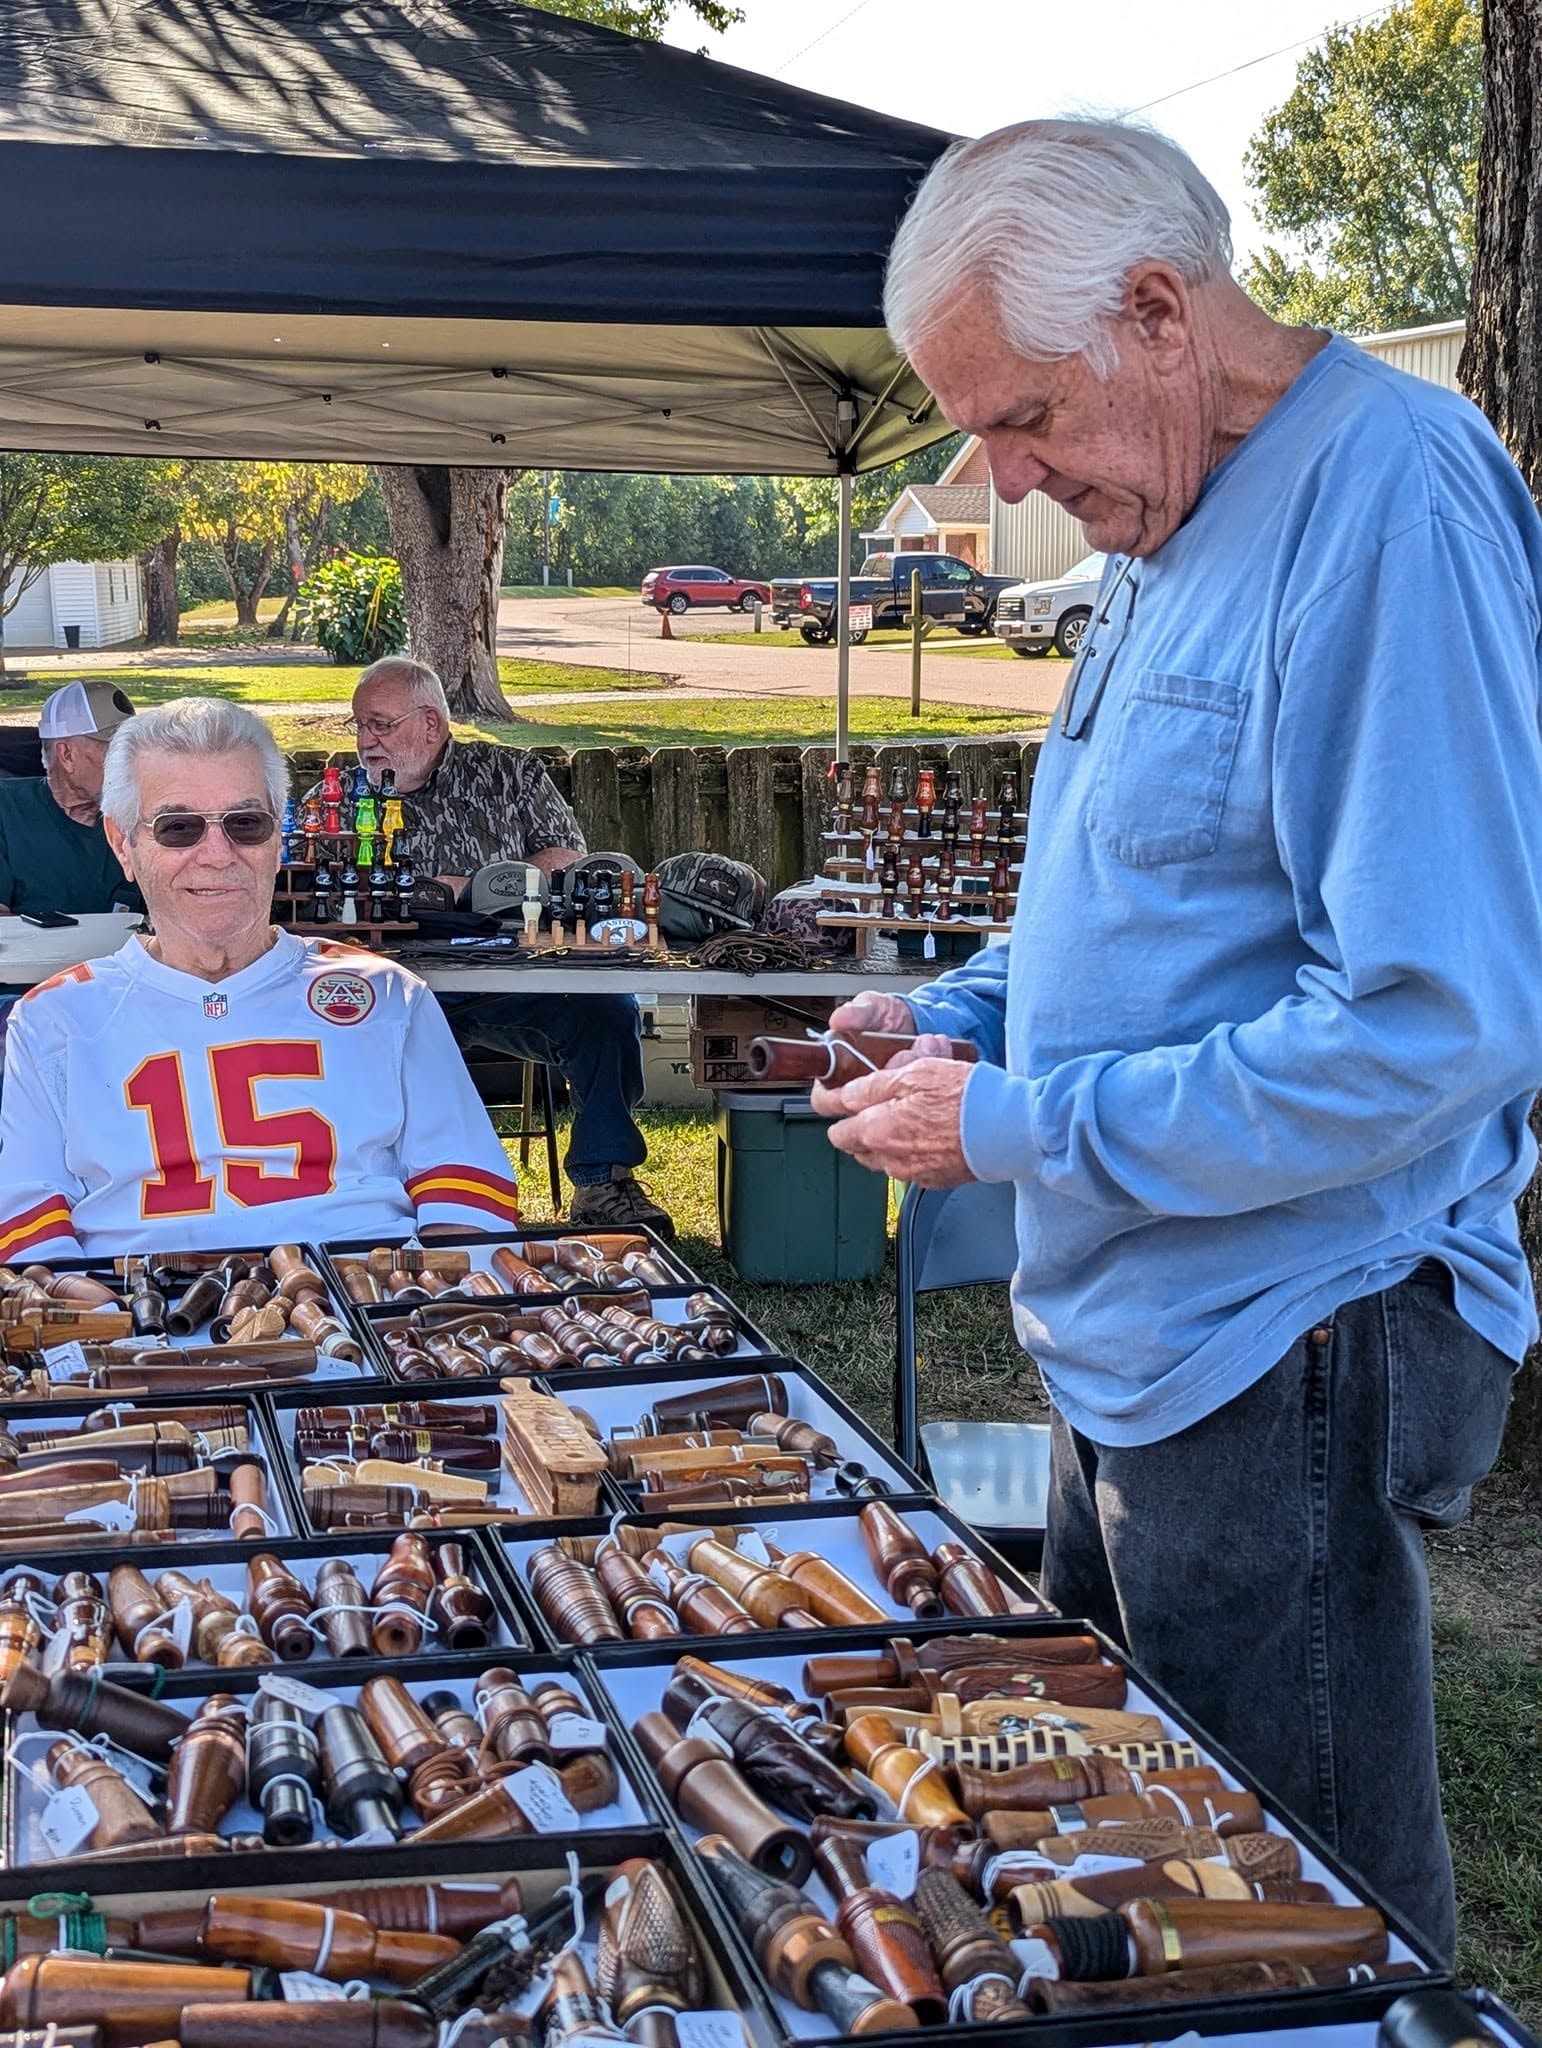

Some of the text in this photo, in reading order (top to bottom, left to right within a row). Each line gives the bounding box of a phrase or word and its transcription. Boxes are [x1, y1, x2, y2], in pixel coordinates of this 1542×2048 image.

[206, 1002, 226, 1016] NFL
[671, 1063, 690, 1074] YE
[124, 1039, 338, 1220] 15
